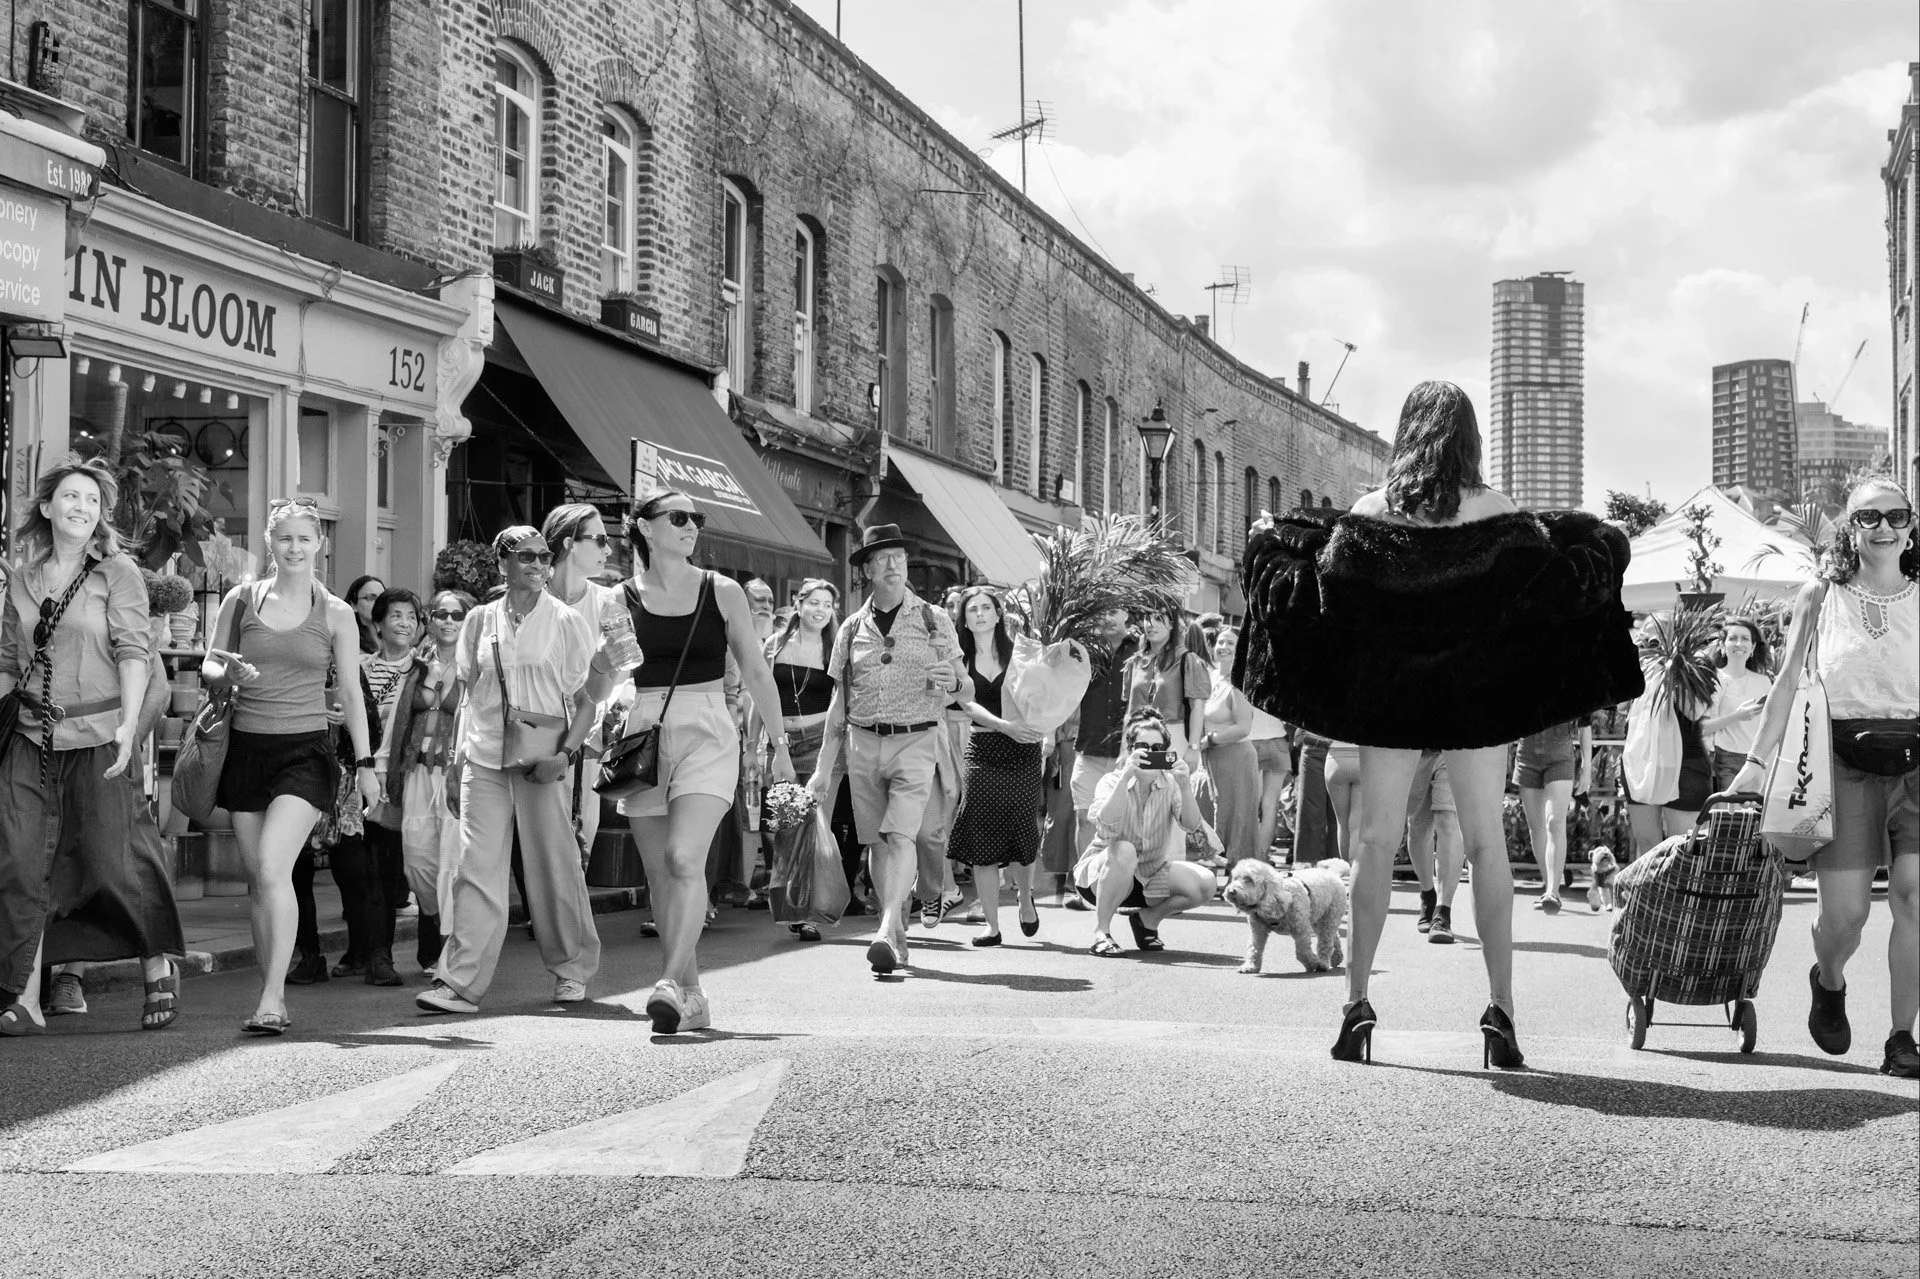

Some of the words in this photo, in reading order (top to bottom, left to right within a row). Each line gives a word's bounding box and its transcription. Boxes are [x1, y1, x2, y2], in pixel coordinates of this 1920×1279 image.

[47, 159, 66, 189] Est.
[530, 270, 555, 294] JACK
[69, 244, 127, 313] IN
[140, 265, 276, 357] BLOOM
[629, 312, 658, 337] GARCIA
[389, 346, 425, 392] 152
[685, 464, 746, 496] GARCIA
